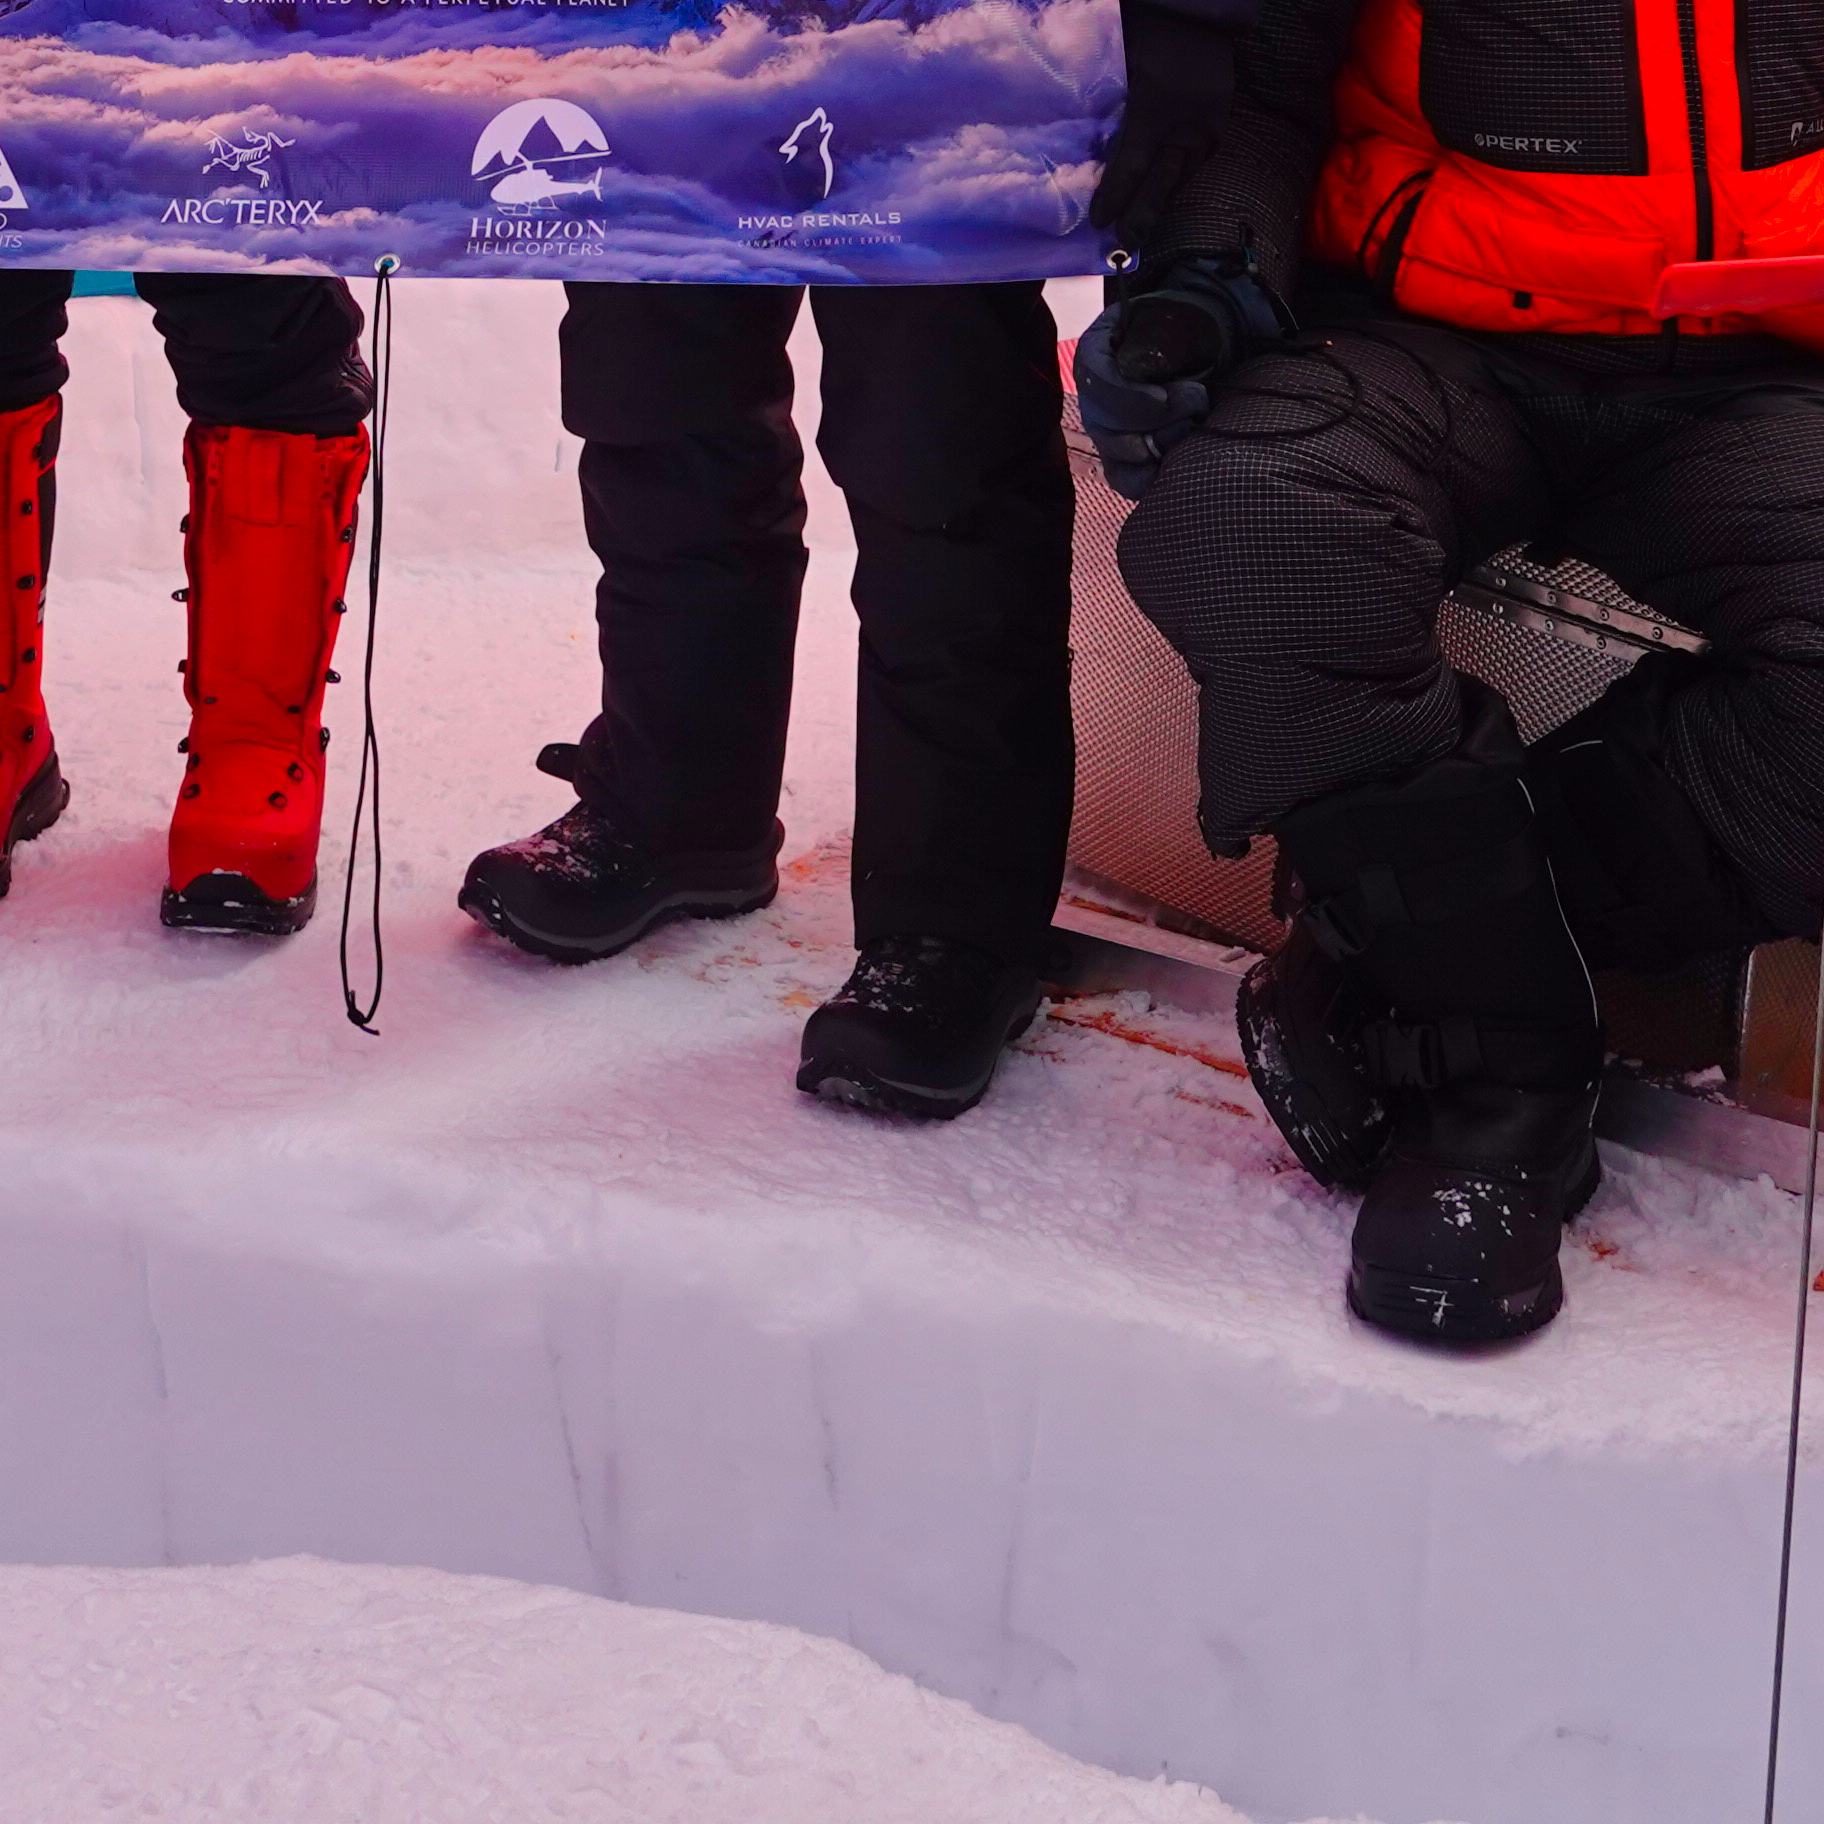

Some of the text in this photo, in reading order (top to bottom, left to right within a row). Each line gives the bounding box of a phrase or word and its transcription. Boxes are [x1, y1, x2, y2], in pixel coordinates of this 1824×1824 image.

[1485, 134, 1579, 154] PERTEX
[160, 198, 324, 225] ARC'TERYX
[738, 212, 902, 229] HVAC RENTALS
[469, 217, 608, 240] HORIZON
[465, 241, 605, 256] HELICOPTERS
[804, 236, 853, 247] CLIMATE
[860, 234, 903, 245] EXPERT
